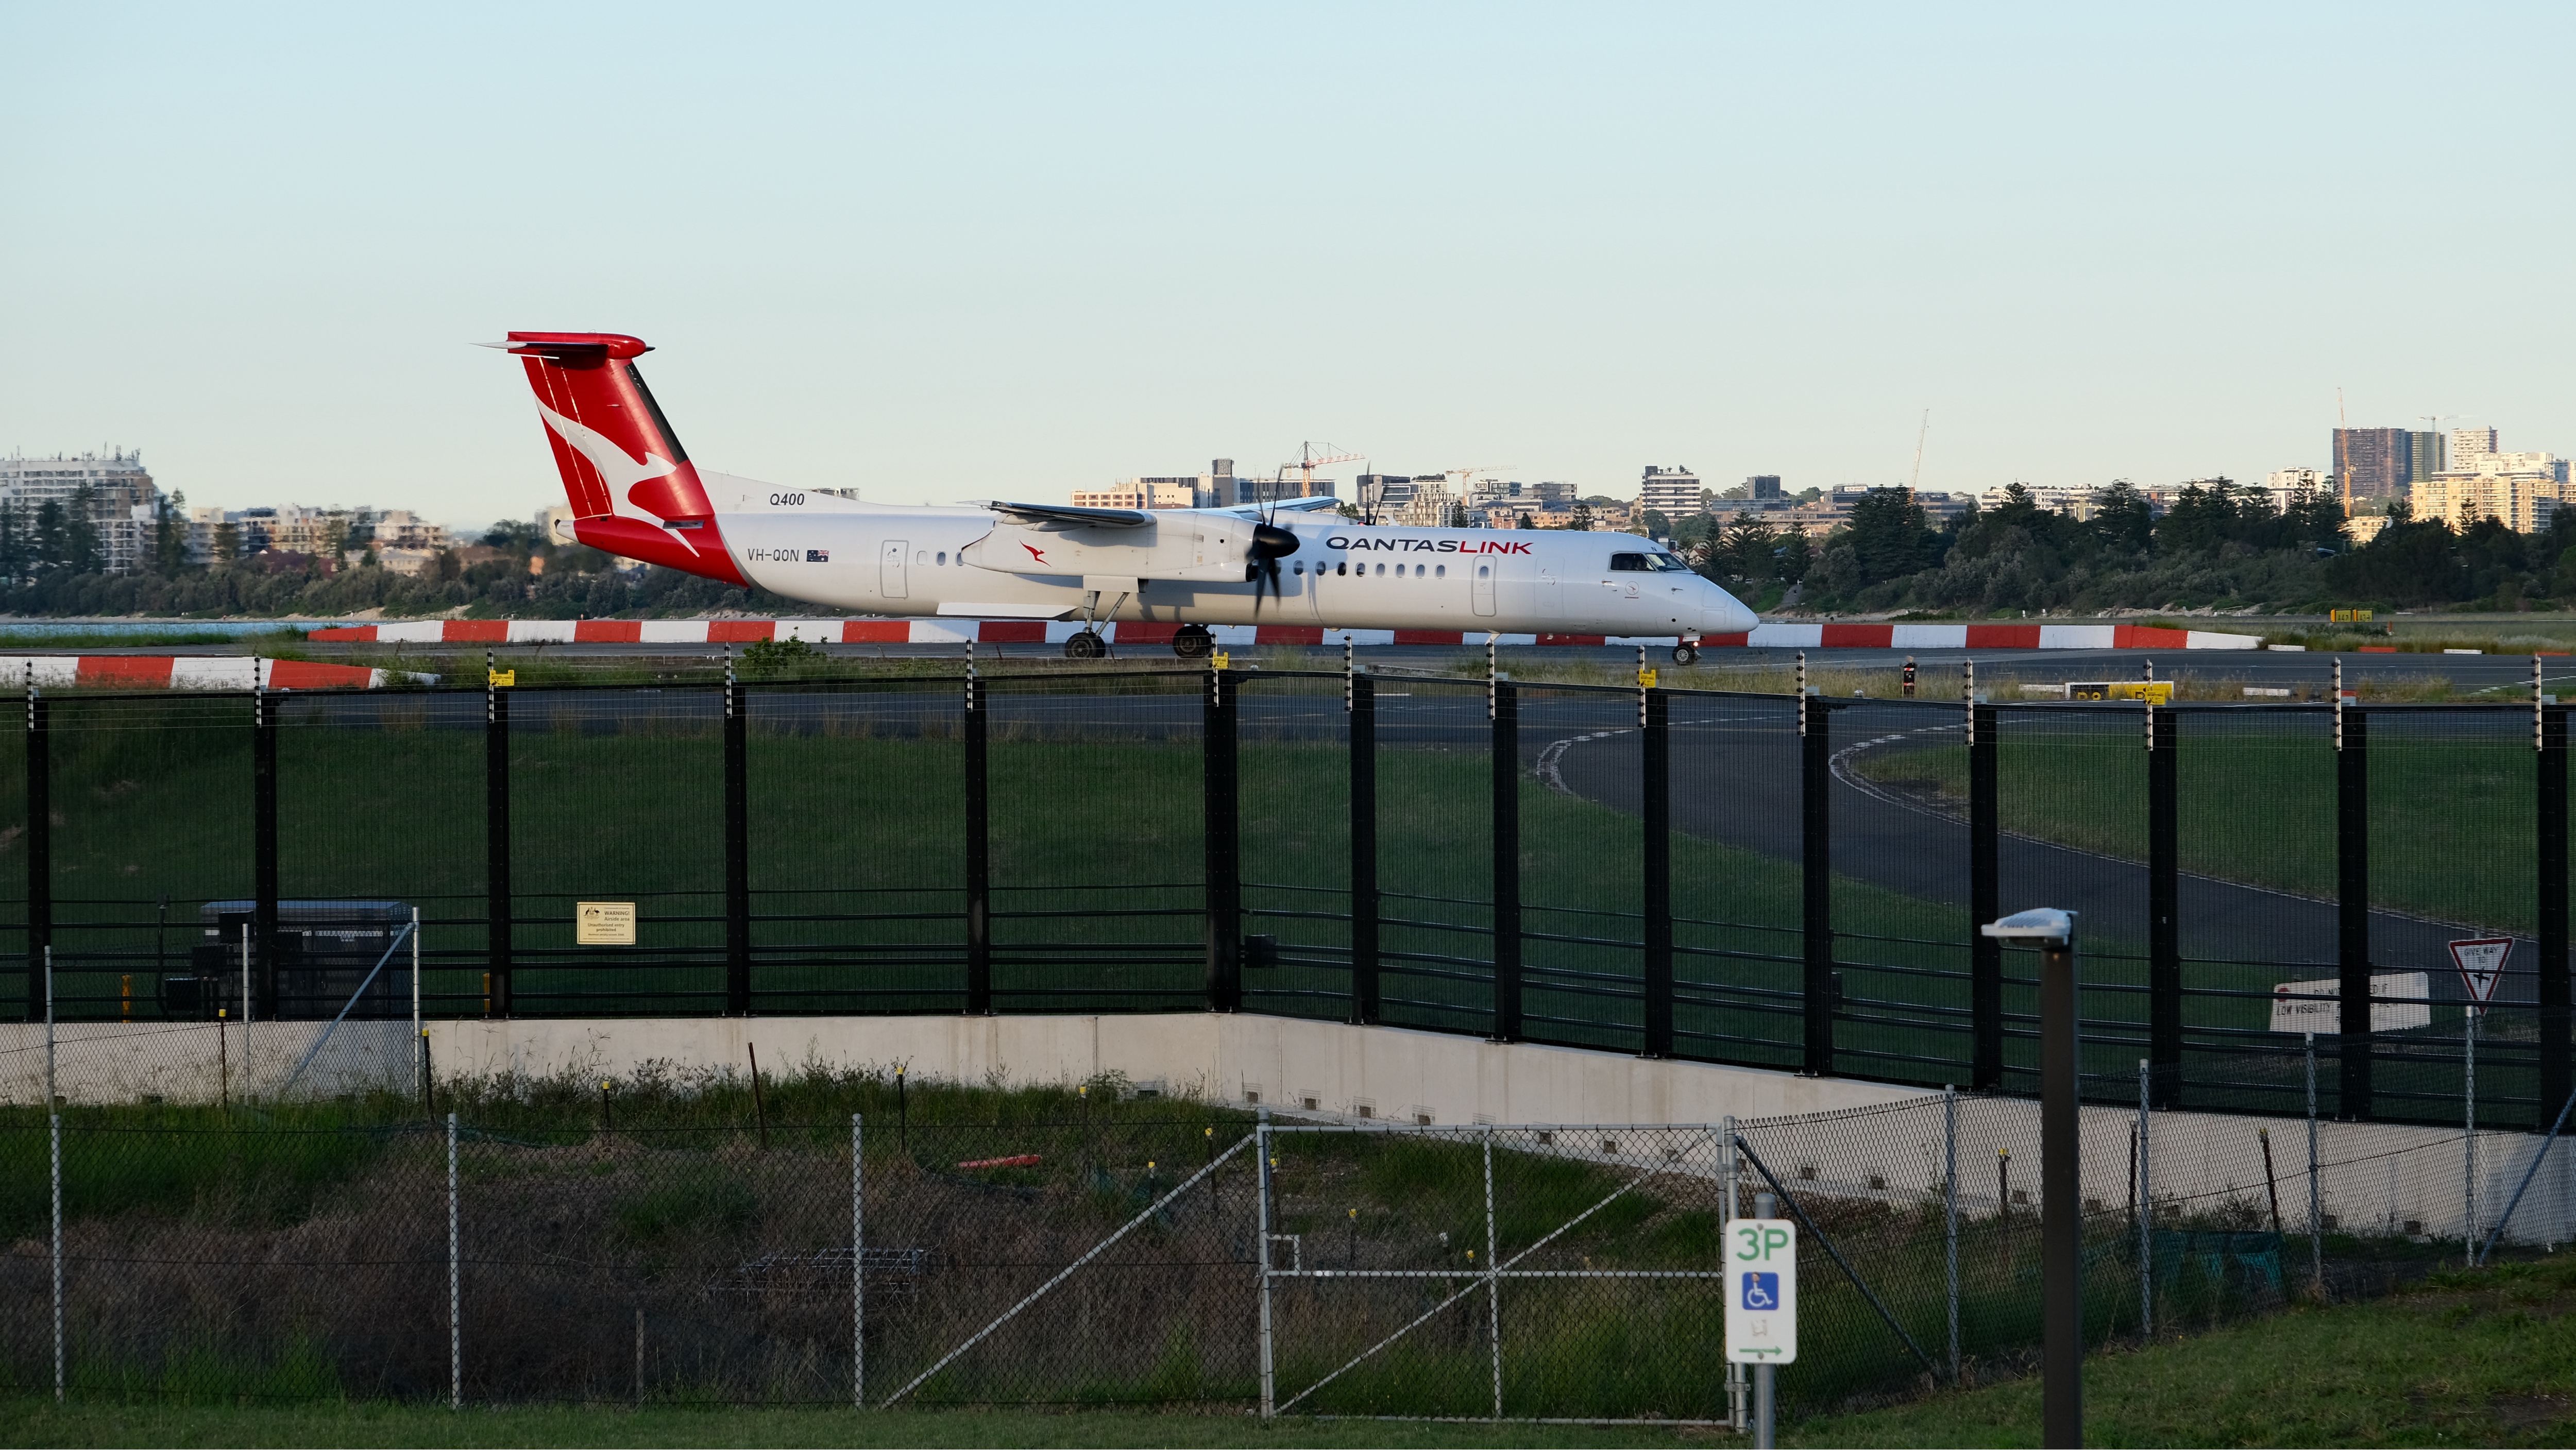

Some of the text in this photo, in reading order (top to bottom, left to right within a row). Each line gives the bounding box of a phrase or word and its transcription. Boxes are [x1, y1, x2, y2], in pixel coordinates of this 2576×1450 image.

[770, 493, 805, 506] Q400
[1326, 536, 1534, 555] QANTASLINK
[748, 548, 799, 562] VH-QON
[2464, 946, 2498, 957] GIVE WAY
[2277, 1005, 2292, 1015] LOW
[2296, 1002, 2331, 1014] VISIBILITY
[1736, 1228, 1789, 1260] 3P
